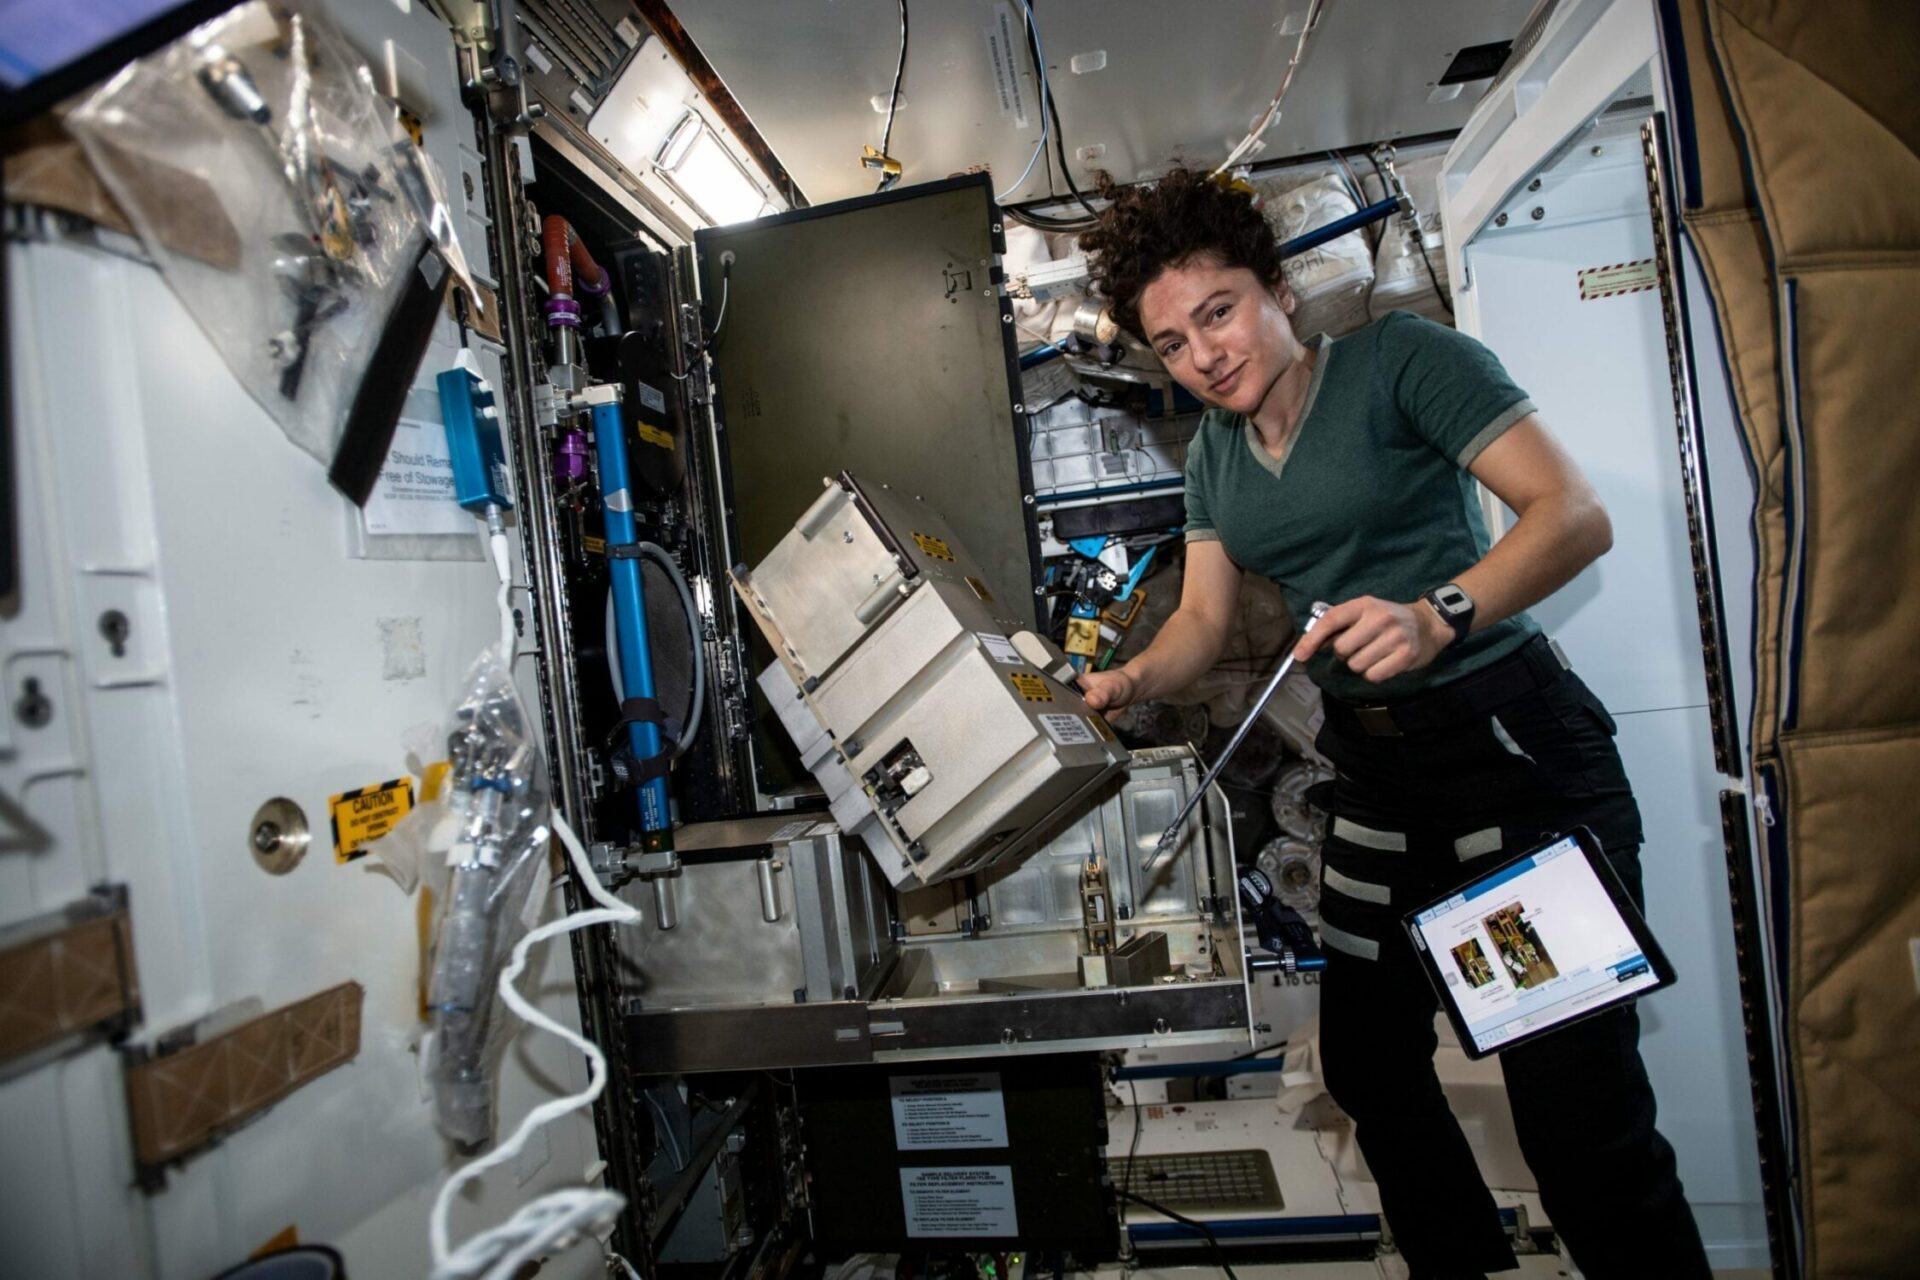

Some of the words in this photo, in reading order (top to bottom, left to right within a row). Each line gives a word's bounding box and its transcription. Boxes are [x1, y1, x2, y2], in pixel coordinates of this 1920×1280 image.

[391, 450, 425, 467] Should
[426, 454, 453, 468] Rema
[404, 470, 414, 483] of
[353, 790, 394, 814] CAUTION
